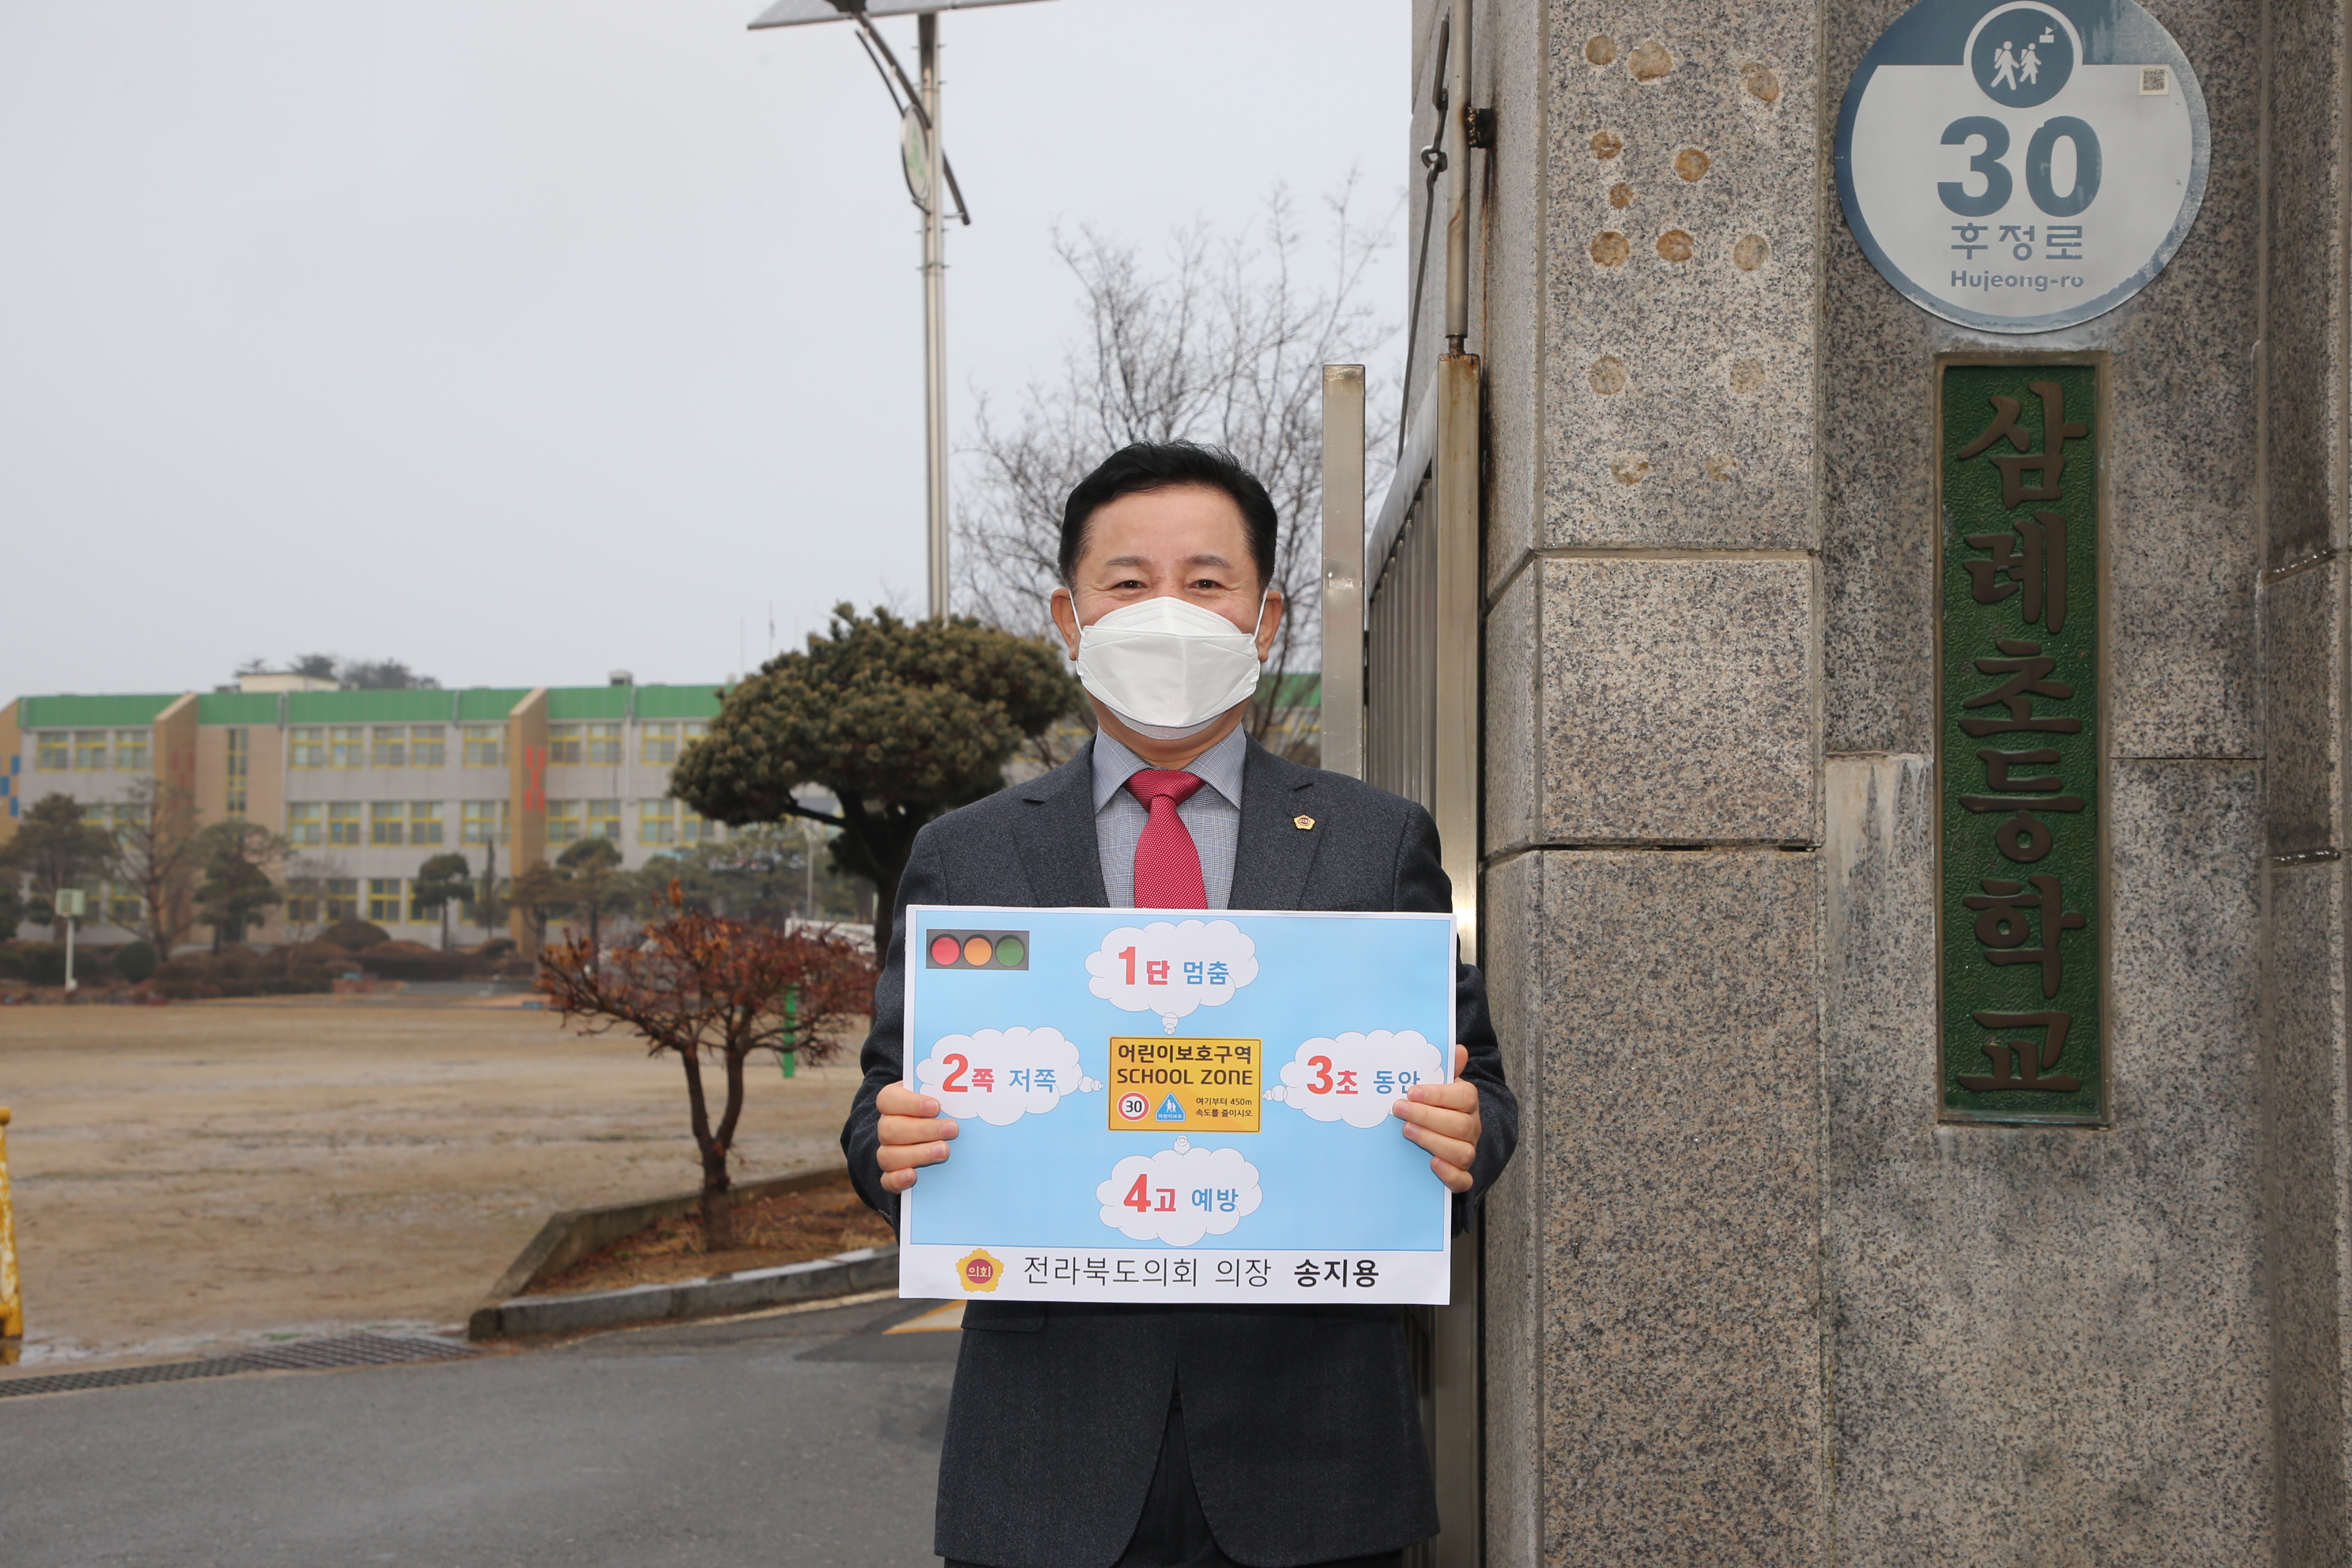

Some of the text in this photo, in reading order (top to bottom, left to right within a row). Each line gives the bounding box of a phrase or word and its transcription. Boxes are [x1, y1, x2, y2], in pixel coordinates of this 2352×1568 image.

[1937, 115, 2103, 218] 30
[1950, 223, 2084, 261] 후정로
[1950, 270, 2085, 292] Hujeong-ro
[1957, 381, 2088, 1092] 삼례초등학교
[1183, 961, 1229, 987] 멈춤
[1118, 1044, 1252, 1064] 어린이보호구역
[943, 1054, 1057, 1094] 2쪽 저쪽
[1117, 1068, 1194, 1084] SCHOOL
[1307, 1055, 1421, 1096] 3초 동안
[1125, 1100, 1143, 1113] 30
[1196, 1098, 1252, 1106] 여기부터 450m
[1196, 1109, 1252, 1117] 속도를 줄이시오
[1124, 1173, 1239, 1213] 4고 예방
[967, 1266, 991, 1278] 의회
[1024, 1256, 1380, 1288] 전라북도의회 의장 송지용
